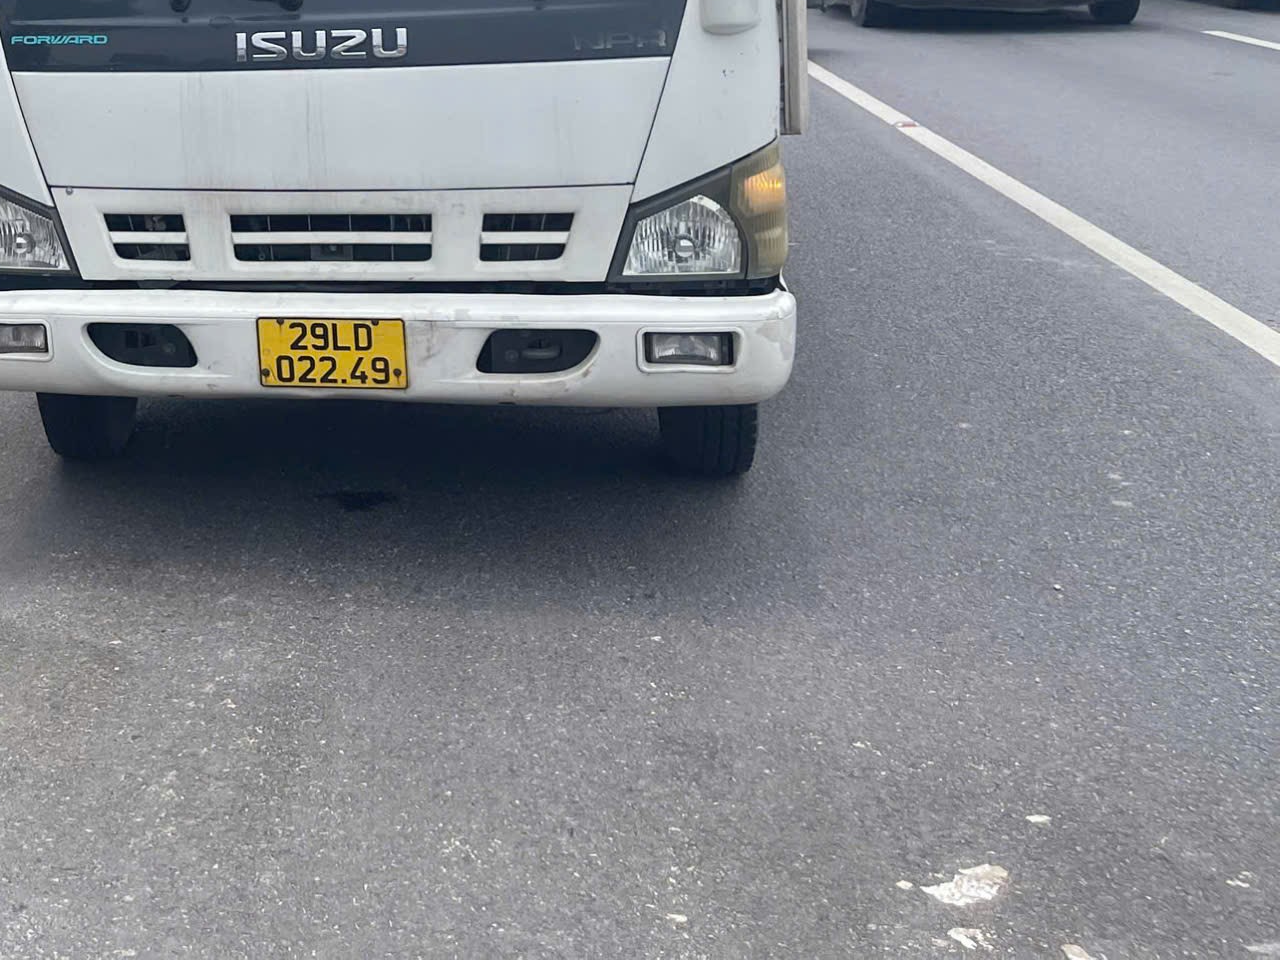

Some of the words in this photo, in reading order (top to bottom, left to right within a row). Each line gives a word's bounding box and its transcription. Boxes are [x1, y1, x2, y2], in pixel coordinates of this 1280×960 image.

[10, 35, 108, 45] FORWARD
[235, 27, 408, 62] ISUZU
[288, 322, 373, 351] 29LD
[275, 355, 390, 384] 022.49
